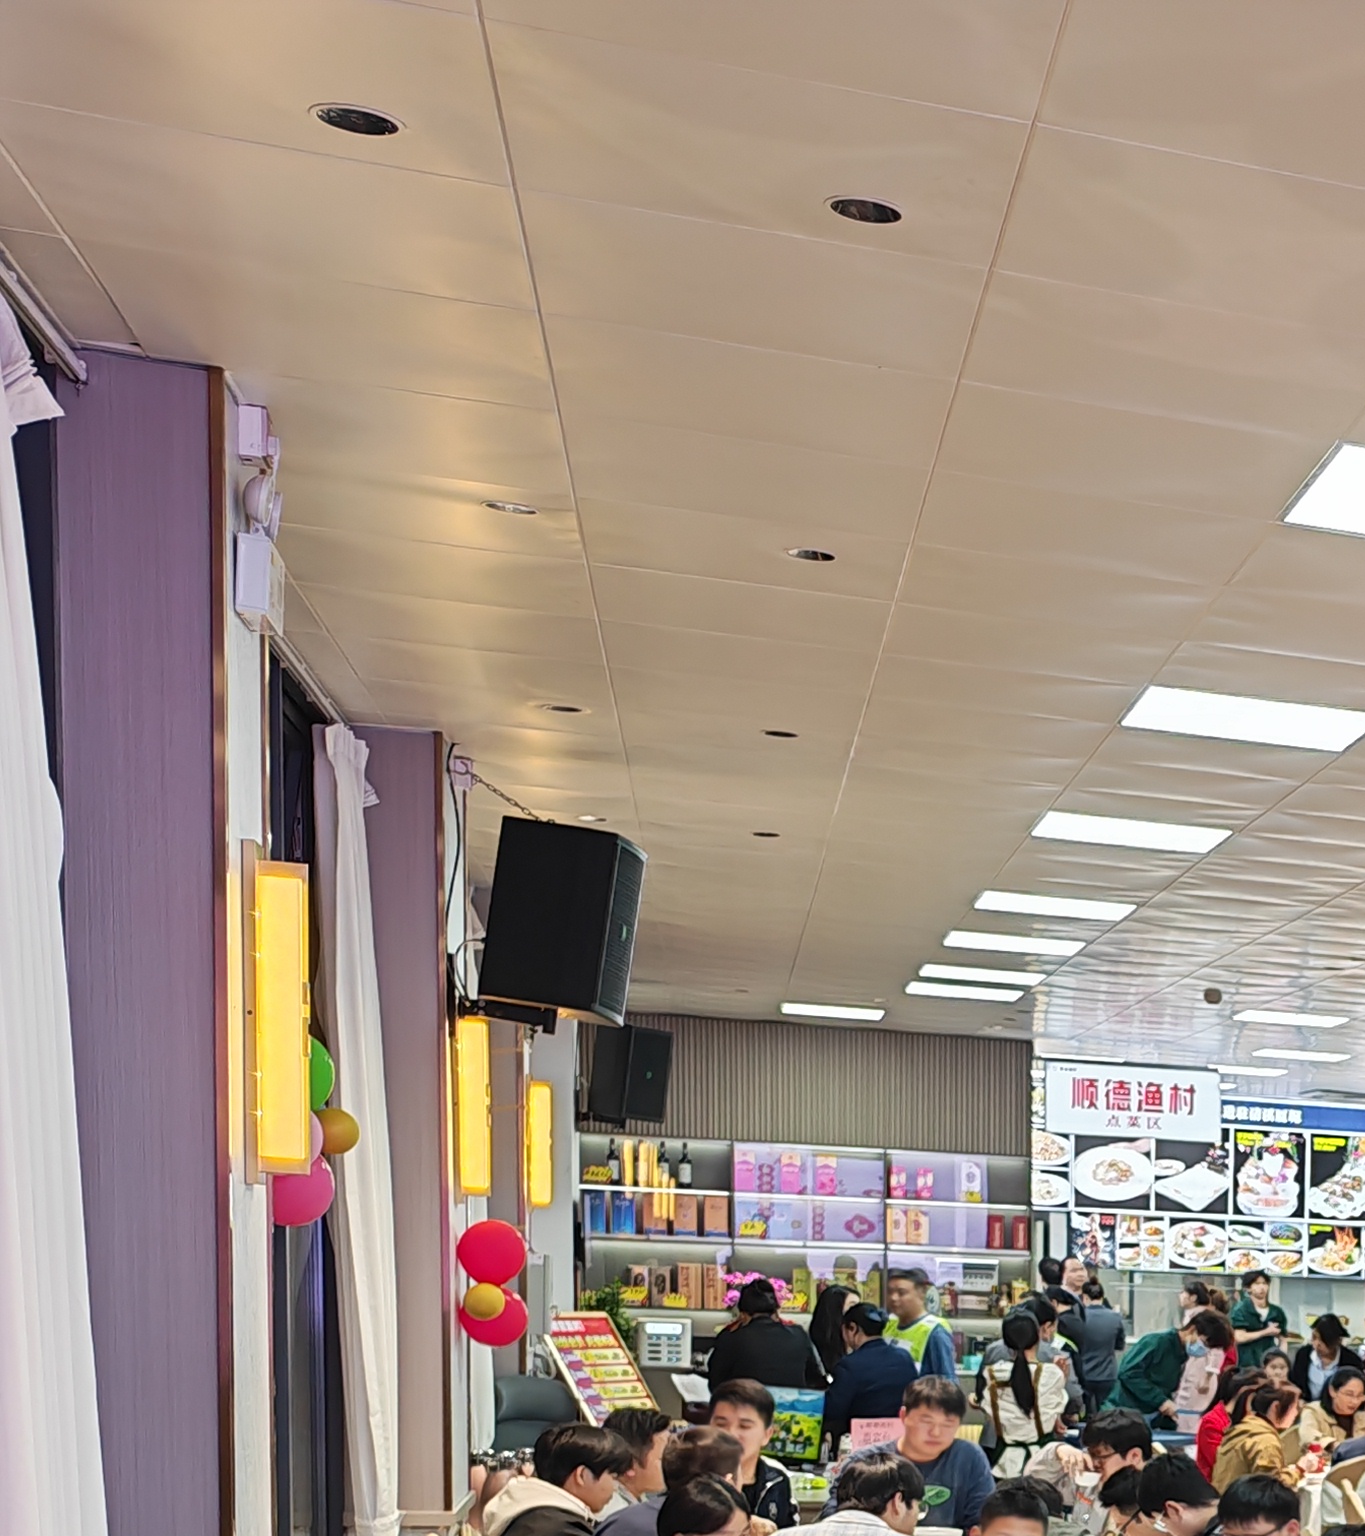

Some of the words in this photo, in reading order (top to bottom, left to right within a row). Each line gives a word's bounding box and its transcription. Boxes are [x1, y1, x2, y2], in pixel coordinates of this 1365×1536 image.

[1071, 1076, 1197, 1116] 顺德渔村
[1105, 1115, 1162, 1131] 点菜区
